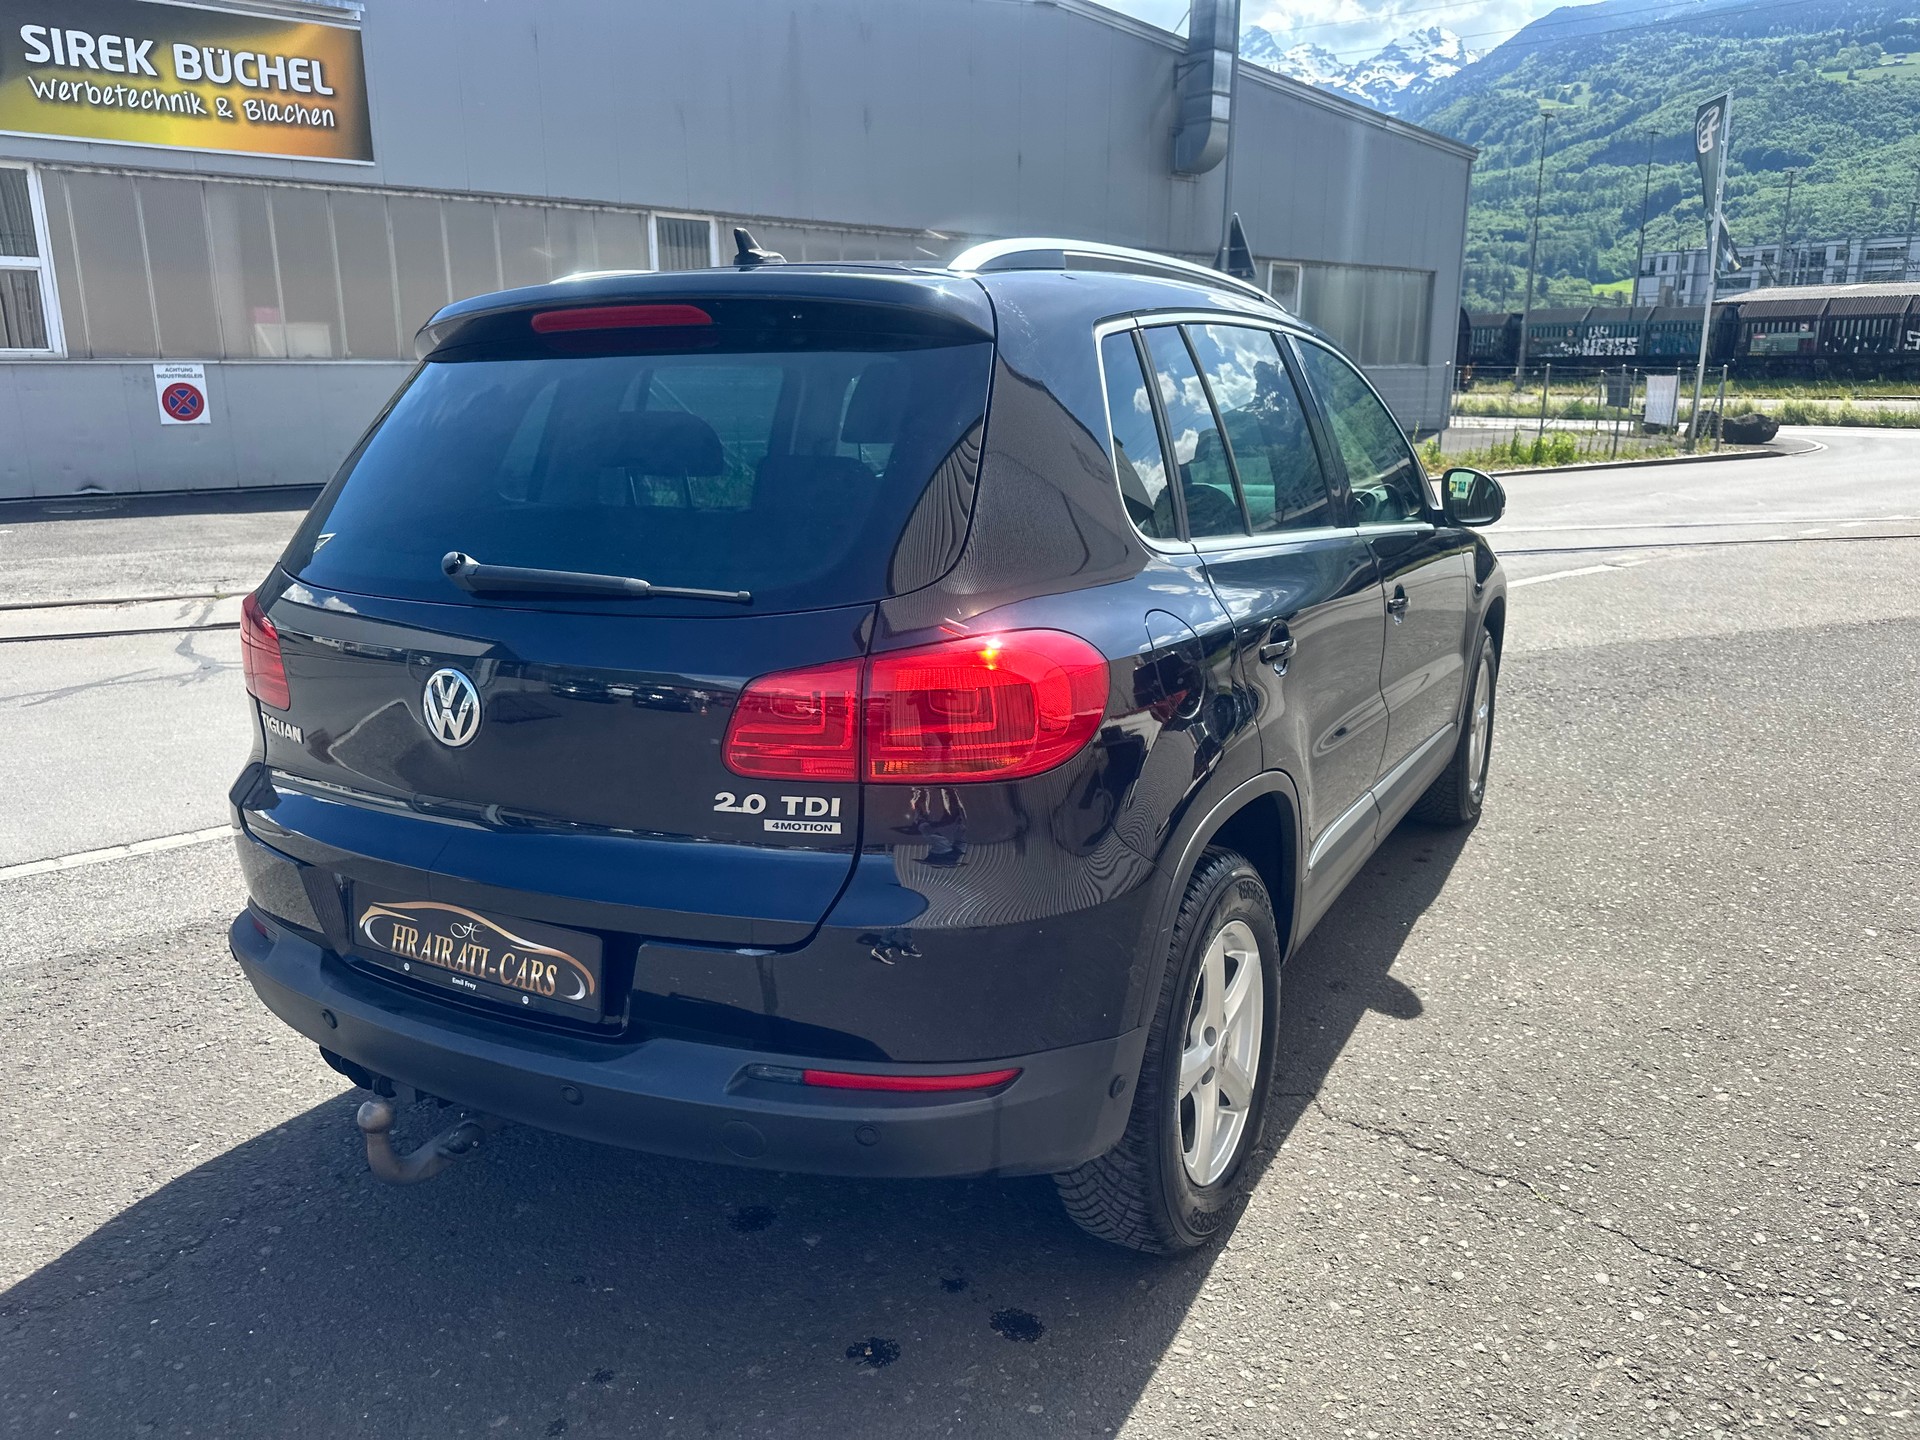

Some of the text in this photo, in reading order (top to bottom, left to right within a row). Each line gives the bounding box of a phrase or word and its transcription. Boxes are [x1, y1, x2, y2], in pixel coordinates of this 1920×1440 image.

[20, 24, 334, 95] SIREK BÜCHEL
[28, 76, 335, 127] Werbetechnik & Blachen
[261, 711, 303, 744] TIGUAN
[781, 796, 840, 817] TDI
[772, 822, 832, 832] 4MOTION
[452, 977, 477, 991] Emil Frey
